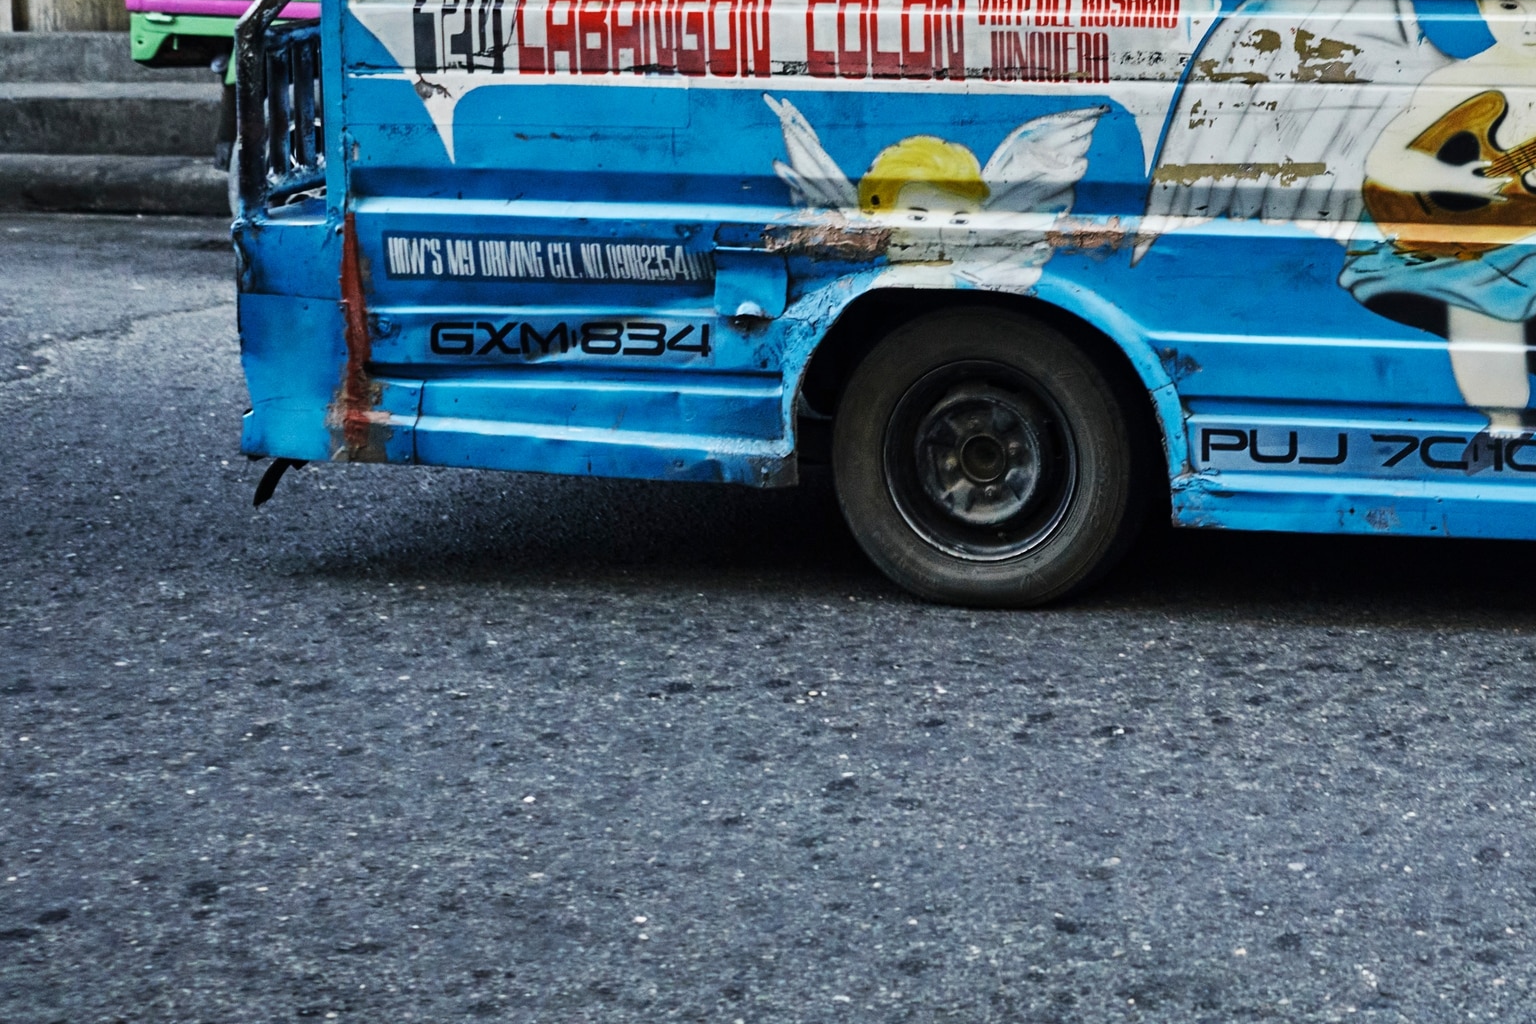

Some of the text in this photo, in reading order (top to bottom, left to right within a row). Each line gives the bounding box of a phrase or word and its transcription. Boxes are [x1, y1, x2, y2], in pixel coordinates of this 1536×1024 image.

[387, 236, 443, 275] HOW'S
[446, 238, 476, 276] MY
[478, 239, 545, 278] DRIVING
[1200, 427, 1349, 466] PUJ
